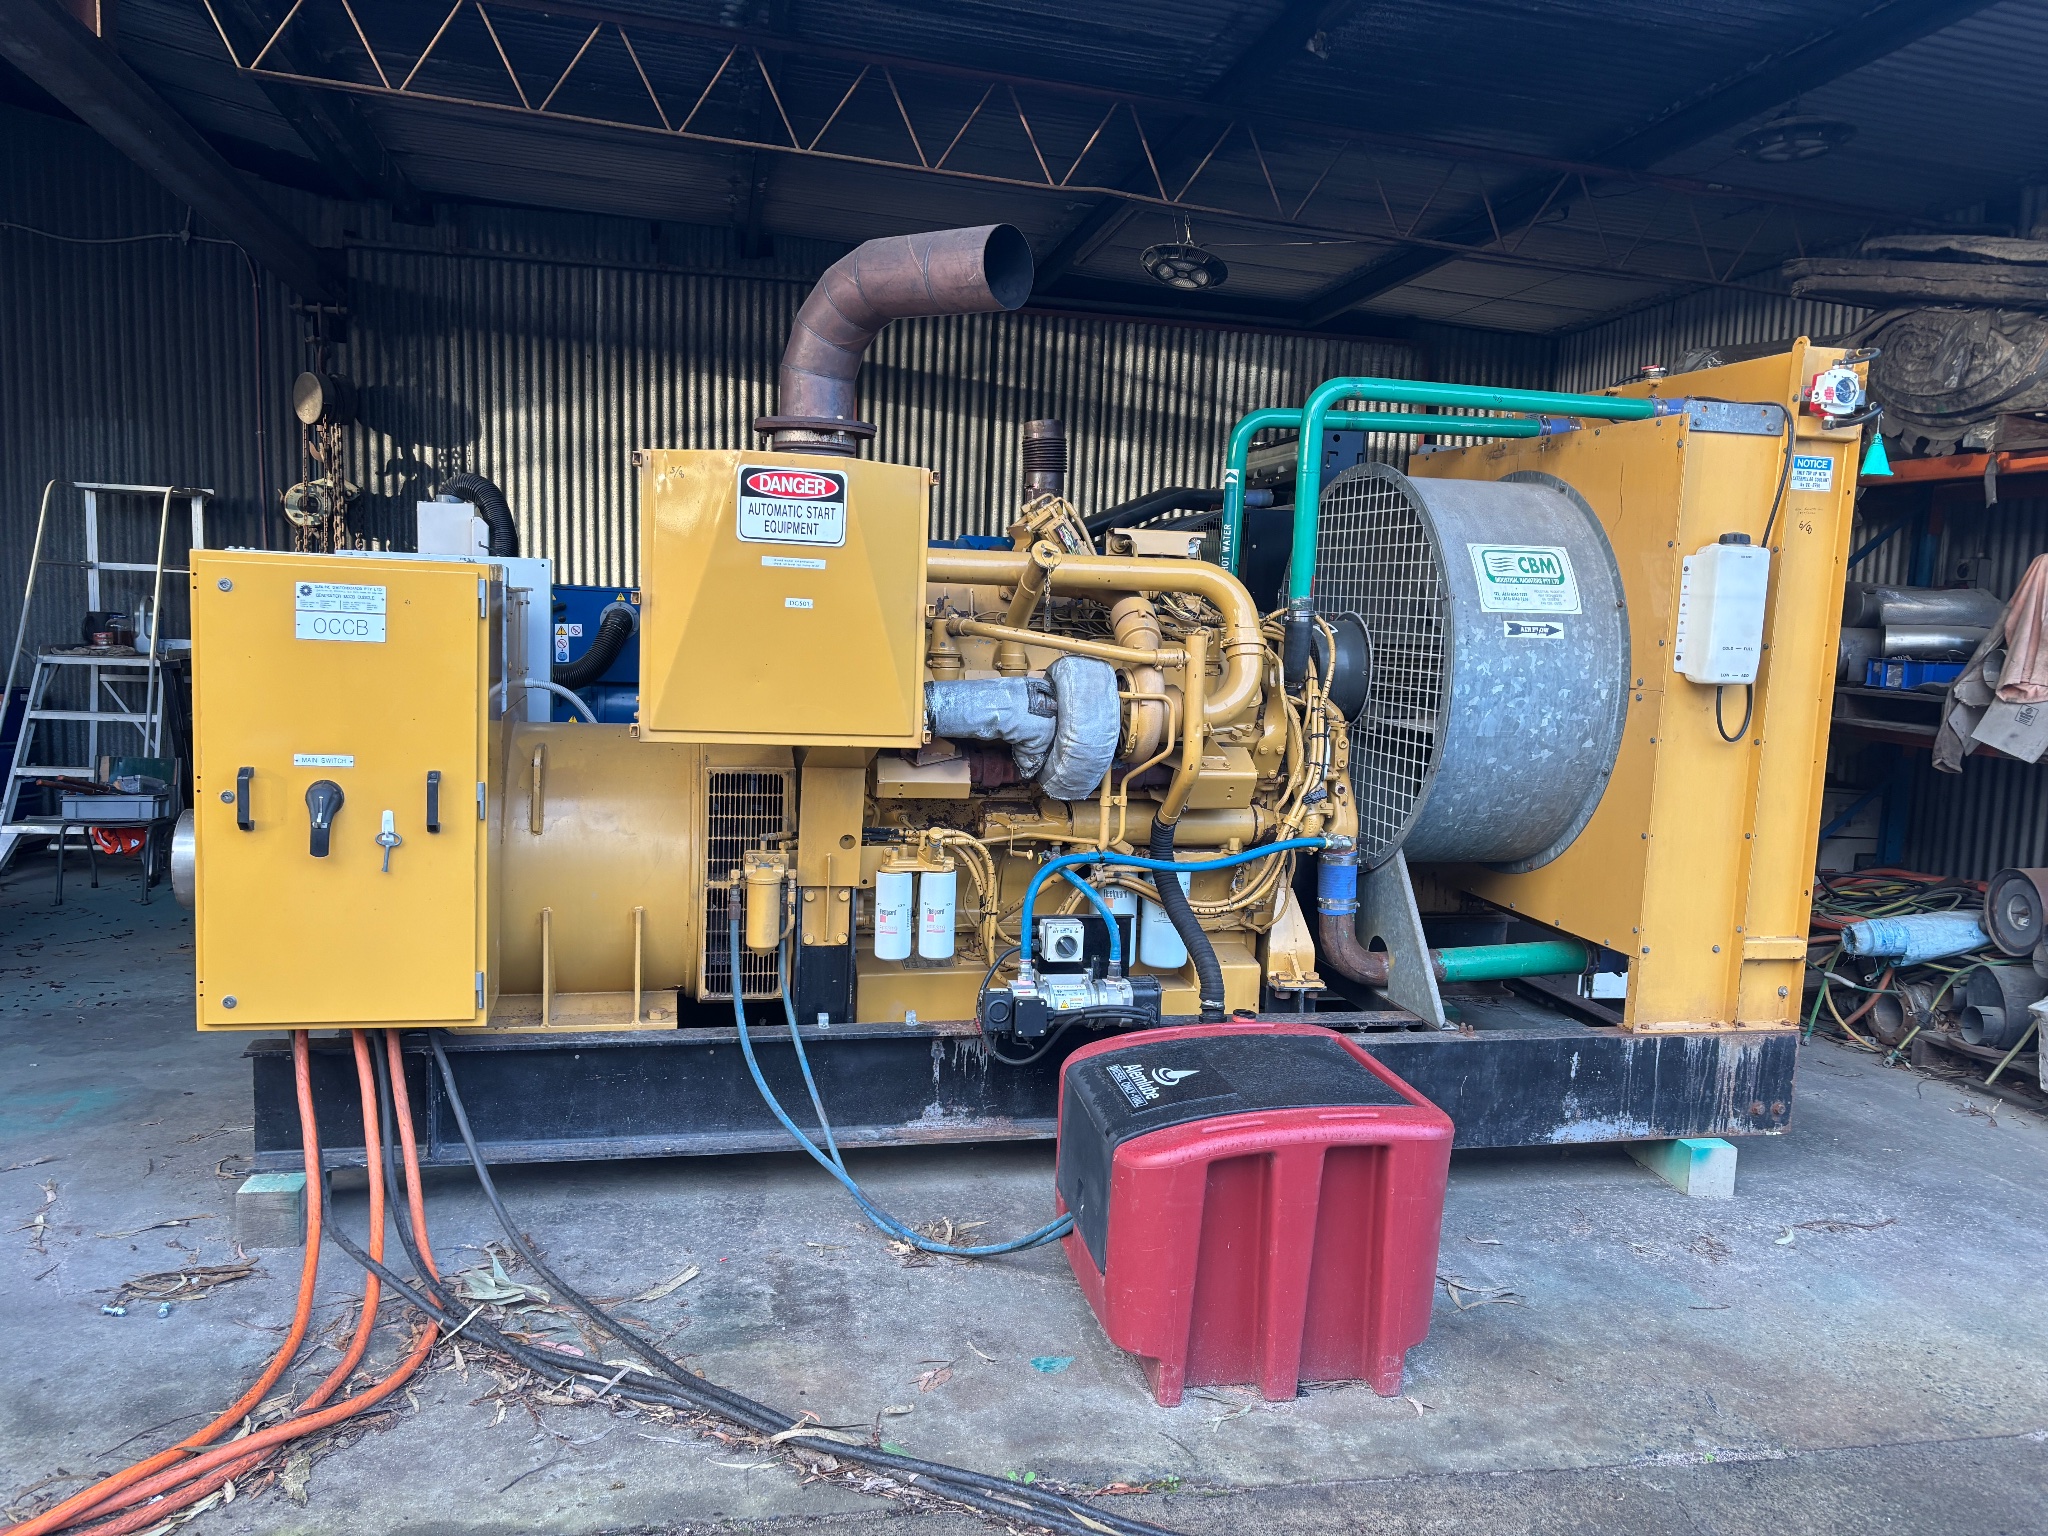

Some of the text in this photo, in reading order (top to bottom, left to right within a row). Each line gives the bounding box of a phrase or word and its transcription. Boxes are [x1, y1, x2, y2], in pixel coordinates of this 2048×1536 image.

[1797, 458, 1828, 469] NOTICE
[759, 474, 826, 495] DANGER
[748, 502, 836, 520] AUTOMATIC START
[764, 519, 819, 536] EQUIPMENT
[1221, 523, 1232, 553] WATER
[1517, 556, 1557, 575] CBM
[313, 617, 369, 636] OCCB
[1108, 1064, 1137, 1095] DIESEL ONLY
[1122, 1064, 1160, 1100] Alemlube
